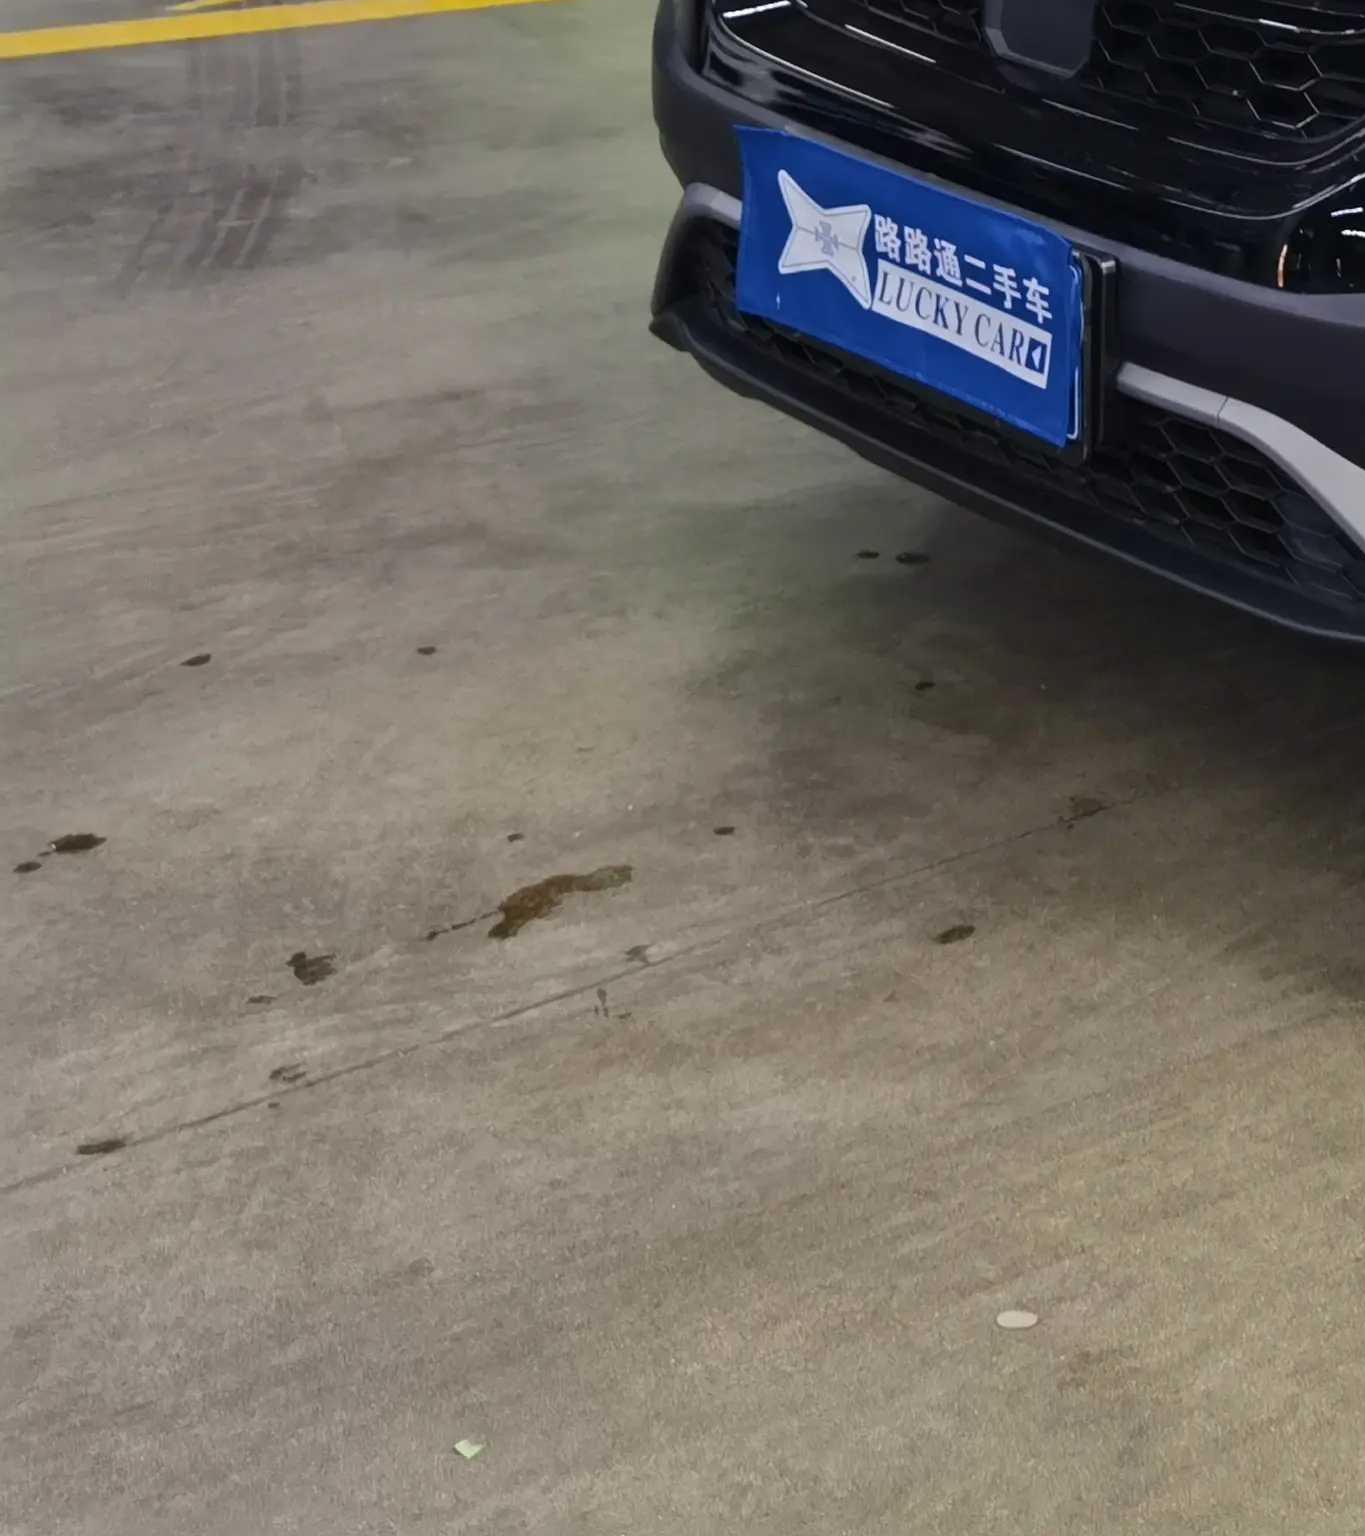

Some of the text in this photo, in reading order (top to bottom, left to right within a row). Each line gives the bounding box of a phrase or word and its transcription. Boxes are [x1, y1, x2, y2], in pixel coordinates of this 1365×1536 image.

[874, 213, 1053, 325] 路路通二手车
[879, 272, 1025, 368] LUCKY CAR
